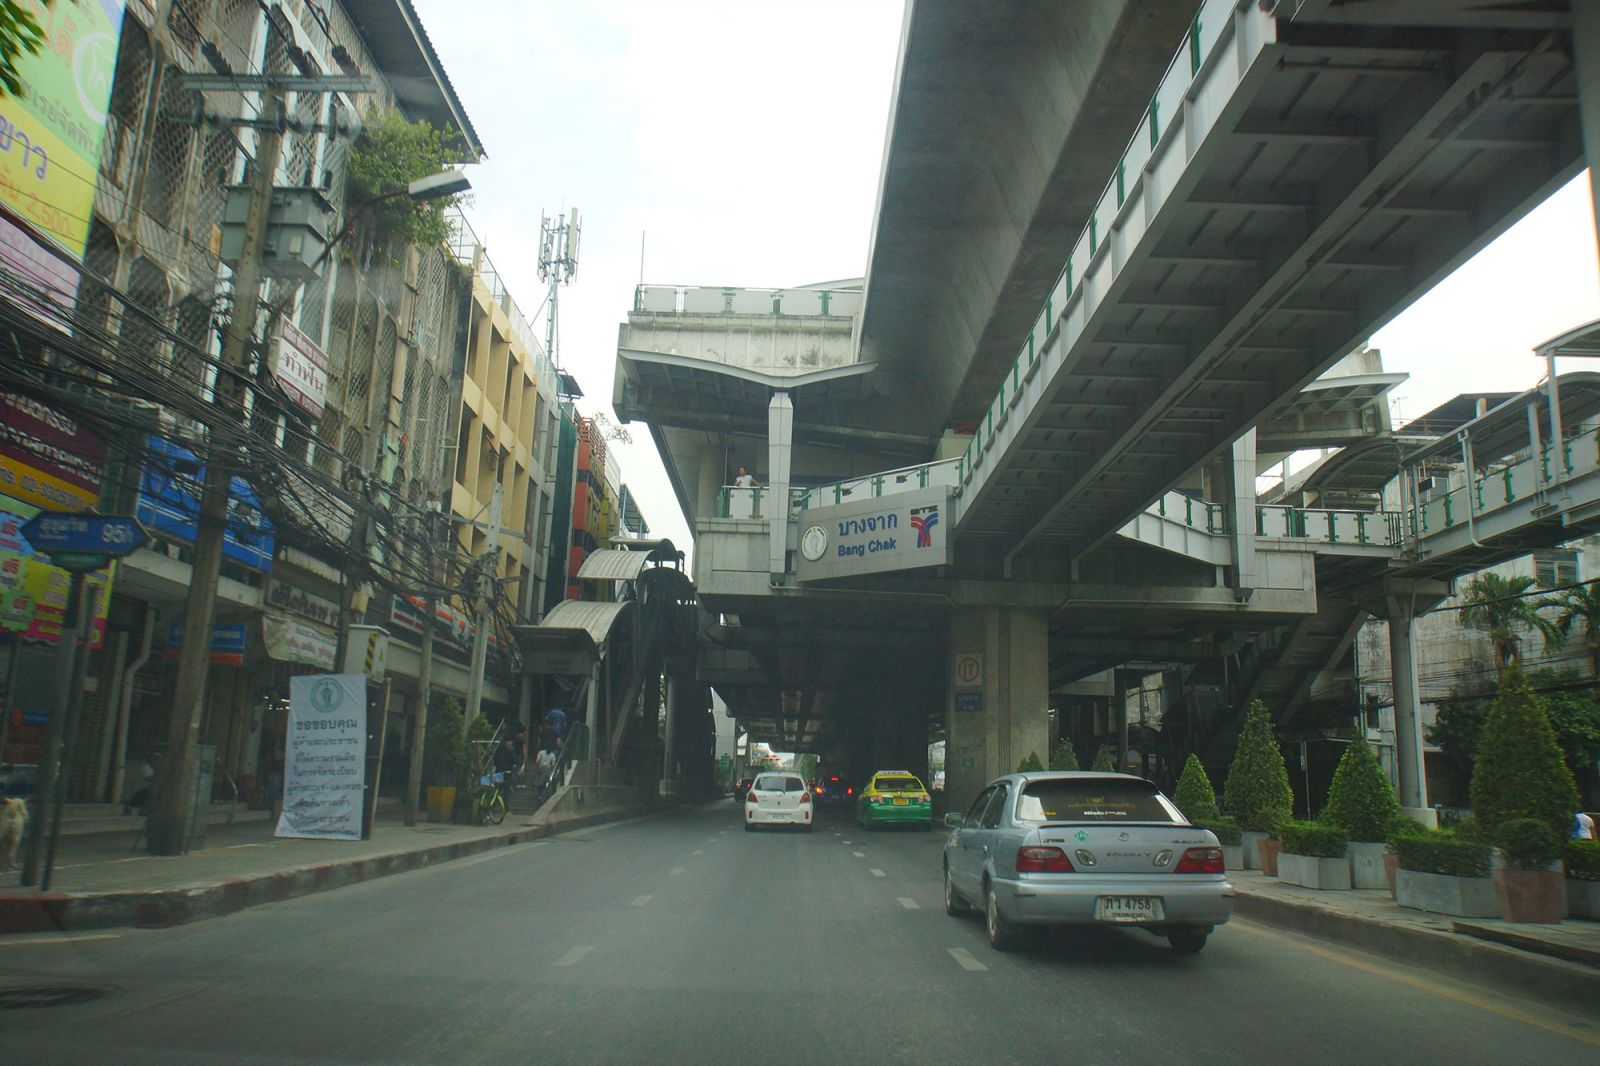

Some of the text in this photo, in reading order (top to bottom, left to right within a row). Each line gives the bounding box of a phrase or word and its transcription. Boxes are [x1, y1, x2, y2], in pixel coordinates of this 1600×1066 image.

[284, 352, 324, 392] ทำฟัน
[910, 505, 938, 515] BTS
[838, 513, 898, 537] บางจาก
[838, 537, 897, 558] Bang Chak
[296, 719, 358, 734] ขอขอบคุณ
[1124, 898, 1152, 910] 4758
